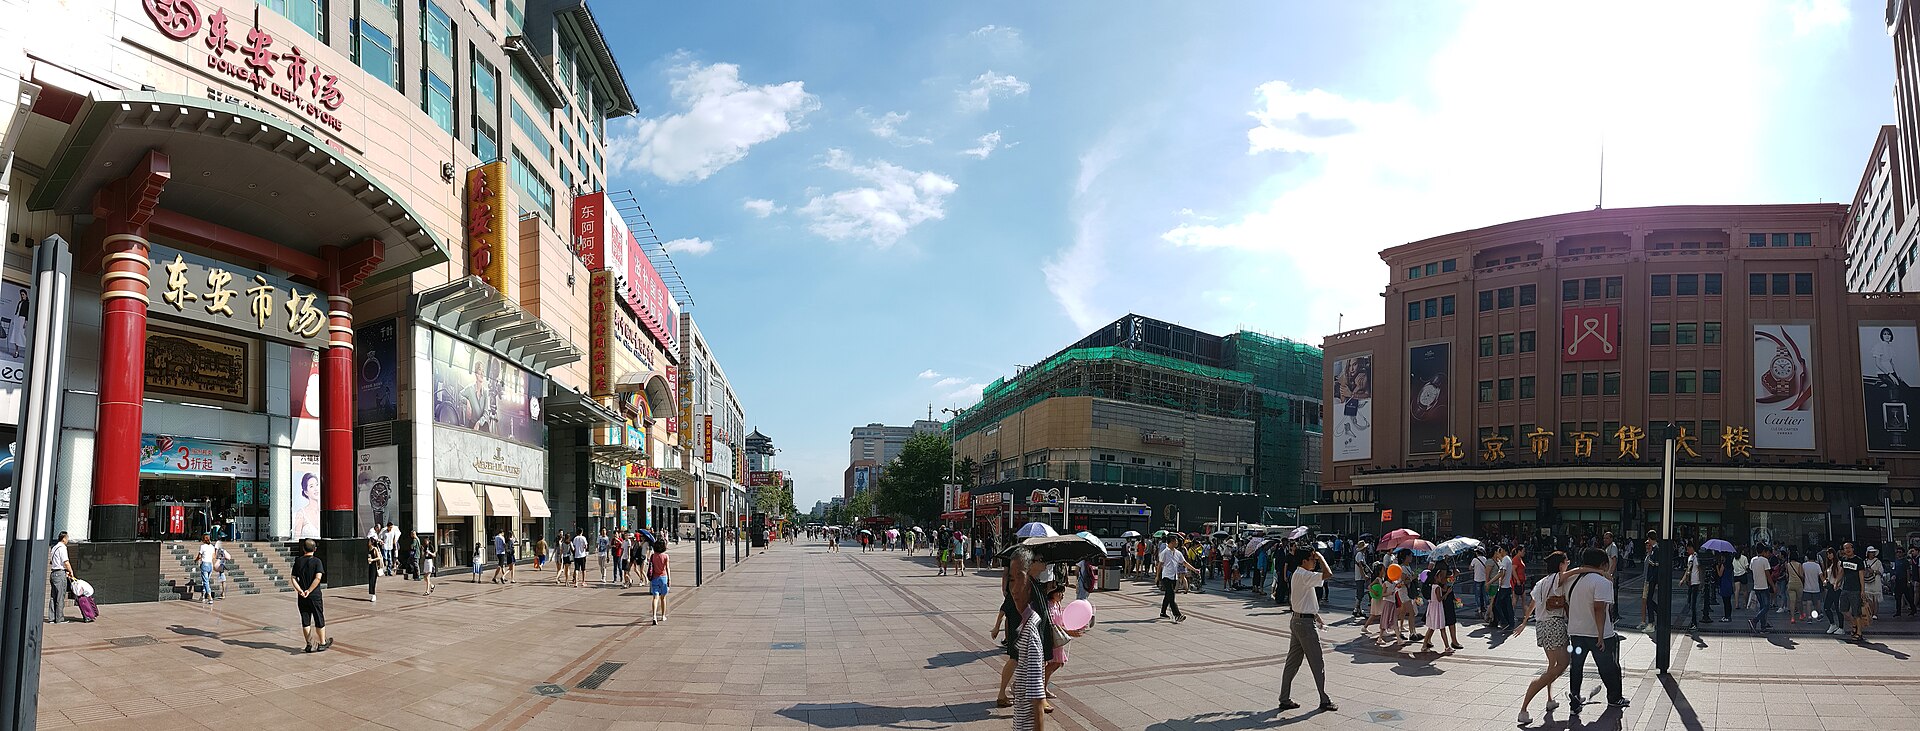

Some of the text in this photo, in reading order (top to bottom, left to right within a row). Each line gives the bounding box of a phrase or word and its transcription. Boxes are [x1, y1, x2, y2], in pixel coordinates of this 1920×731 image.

[205, 7, 345, 110] 东安市场
[207, 54, 267, 90] DONGAN
[306, 104, 343, 132] STORE
[162, 253, 327, 338] 东安市场
[1439, 425, 1754, 463] 北京市百货大楼
[1764, 413, 1805, 425] Cartier
[630, 479, 643, 487] New
